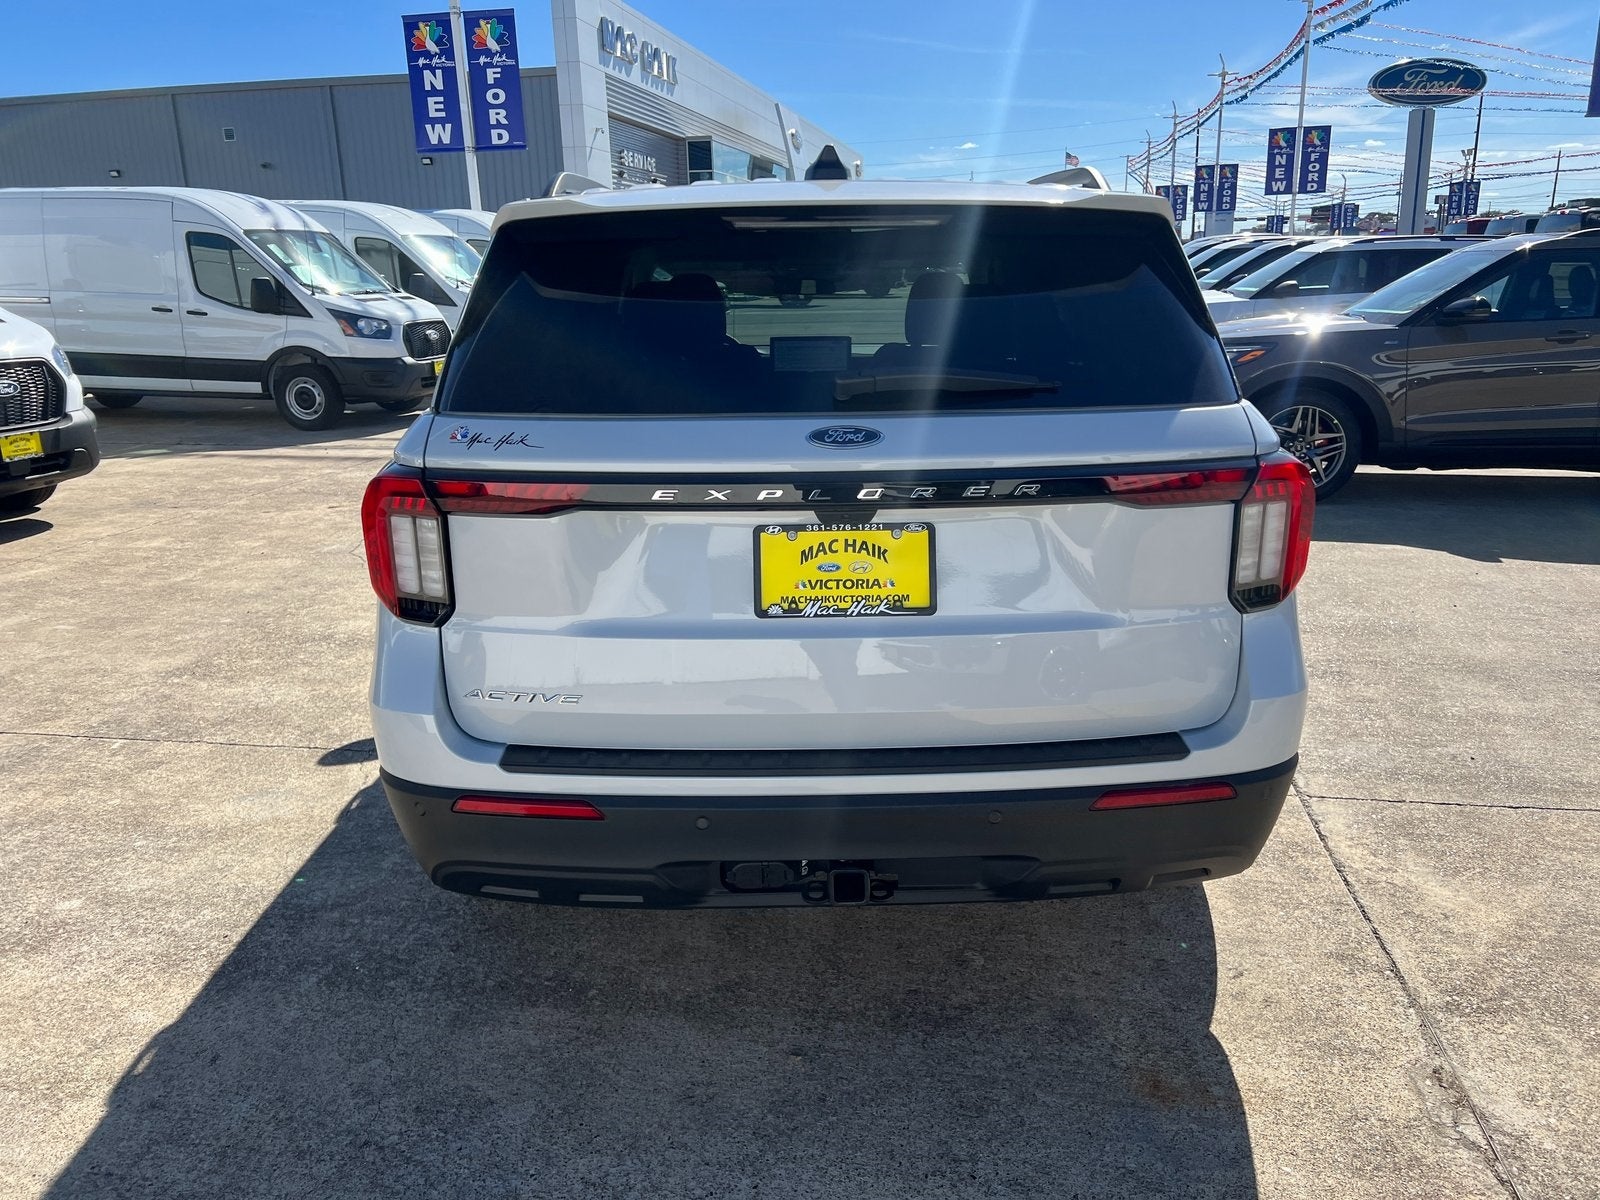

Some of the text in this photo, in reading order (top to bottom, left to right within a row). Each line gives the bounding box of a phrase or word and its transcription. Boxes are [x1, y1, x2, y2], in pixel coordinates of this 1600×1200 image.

[600, 16, 679, 87] MAC HAIK
[1396, 68, 1465, 91] Ford
[423, 69, 452, 145] NEW
[486, 67, 510, 145] FORD
[623, 149, 657, 173] SERVICE
[1306, 153, 1320, 191] FORD
[1271, 154, 1287, 192] NEW
[1198, 183, 1209, 210] NEW
[1222, 182, 1231, 210] FORD
[1450, 195, 1459, 214] NEW
[1467, 194, 1475, 214] FORD
[466, 431, 541, 451] Mac Haik
[824, 428, 866, 442] Ford
[651, 484, 1041, 501] EXPLORER
[805, 523, 884, 532] 361-576-1221
[800, 538, 889, 566] MAC HAIK
[807, 578, 882, 591] VICTORIA
[801, 599, 901, 617] Mac Haik
[463, 688, 584, 706] ACTIVE
